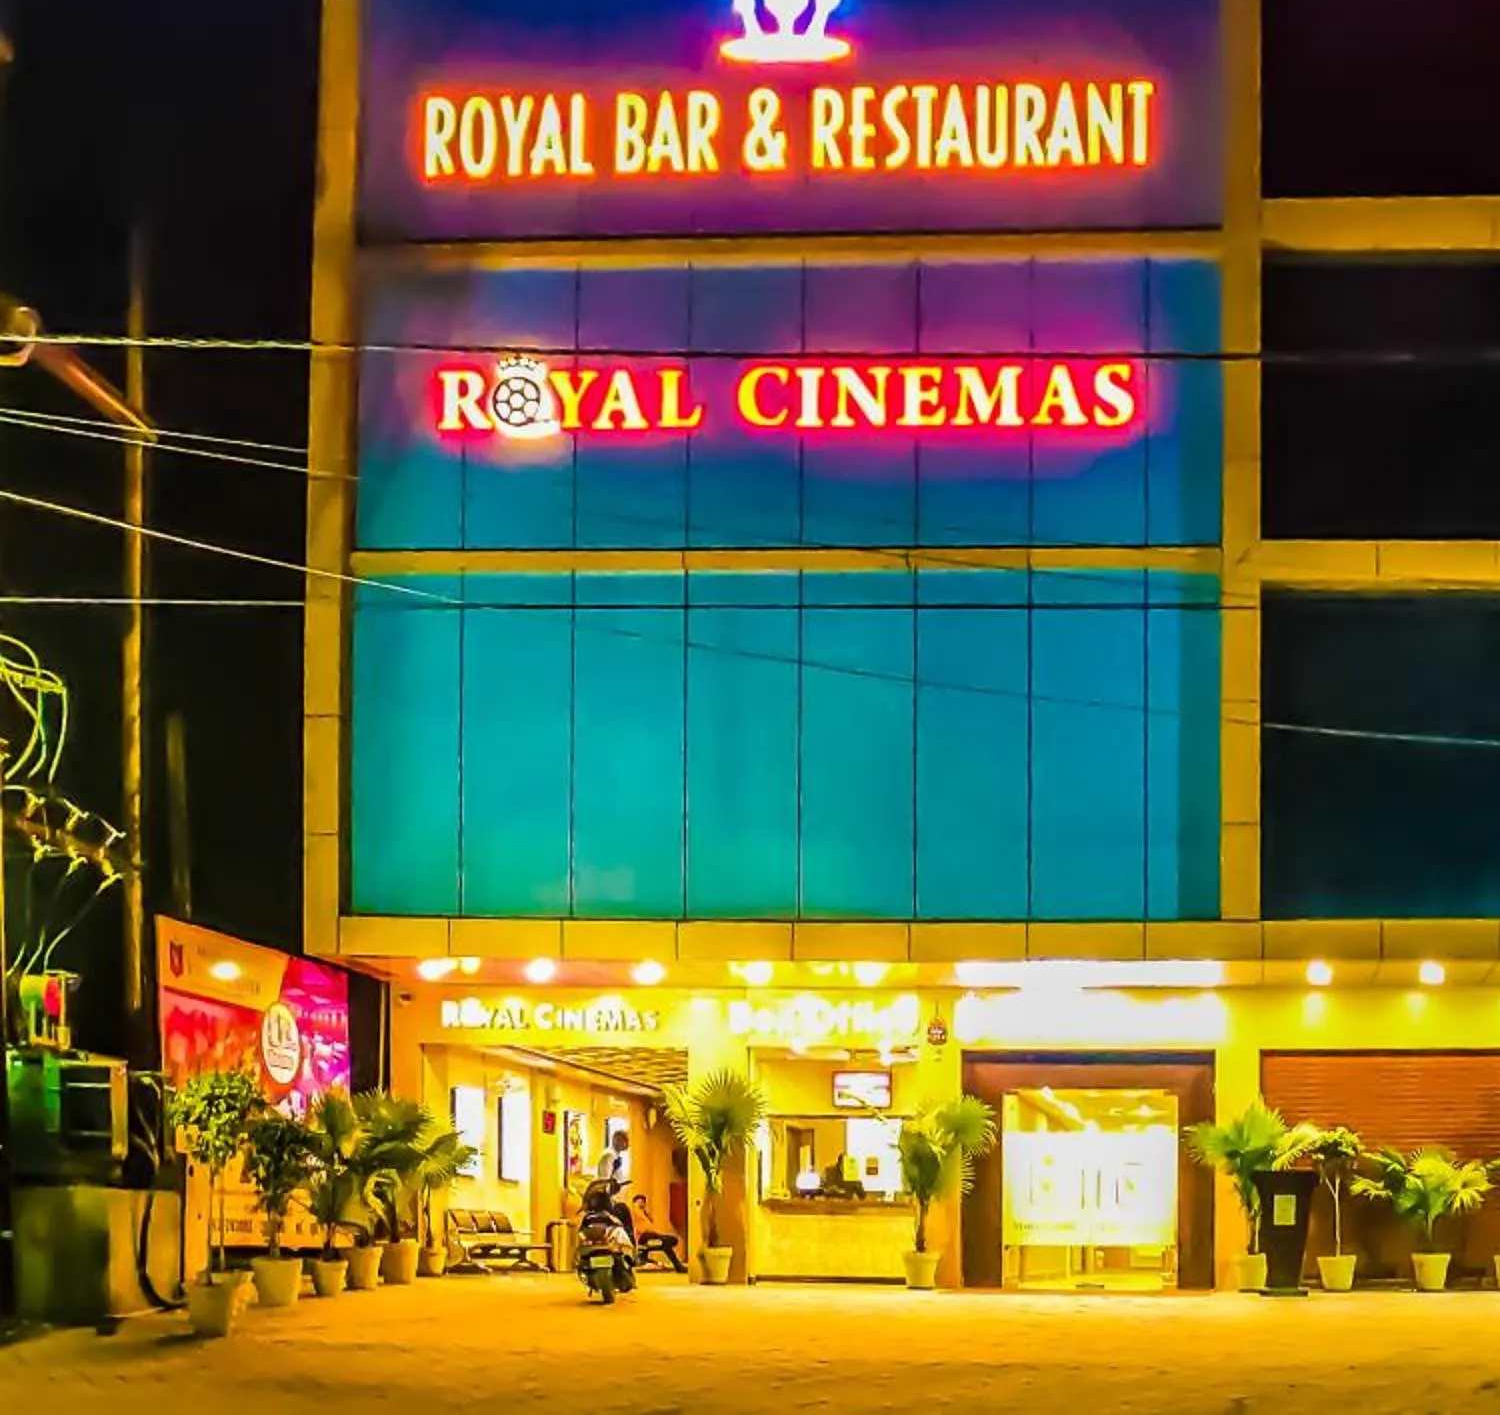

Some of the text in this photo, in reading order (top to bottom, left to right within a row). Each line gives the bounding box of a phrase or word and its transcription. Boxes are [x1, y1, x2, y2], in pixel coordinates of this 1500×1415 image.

[424, 80, 1156, 178] ROYAL BAR & RESTAURANT
[438, 356, 1138, 438] ROYAL CINEMAS
[534, 1001, 659, 1032] CINEMAS
